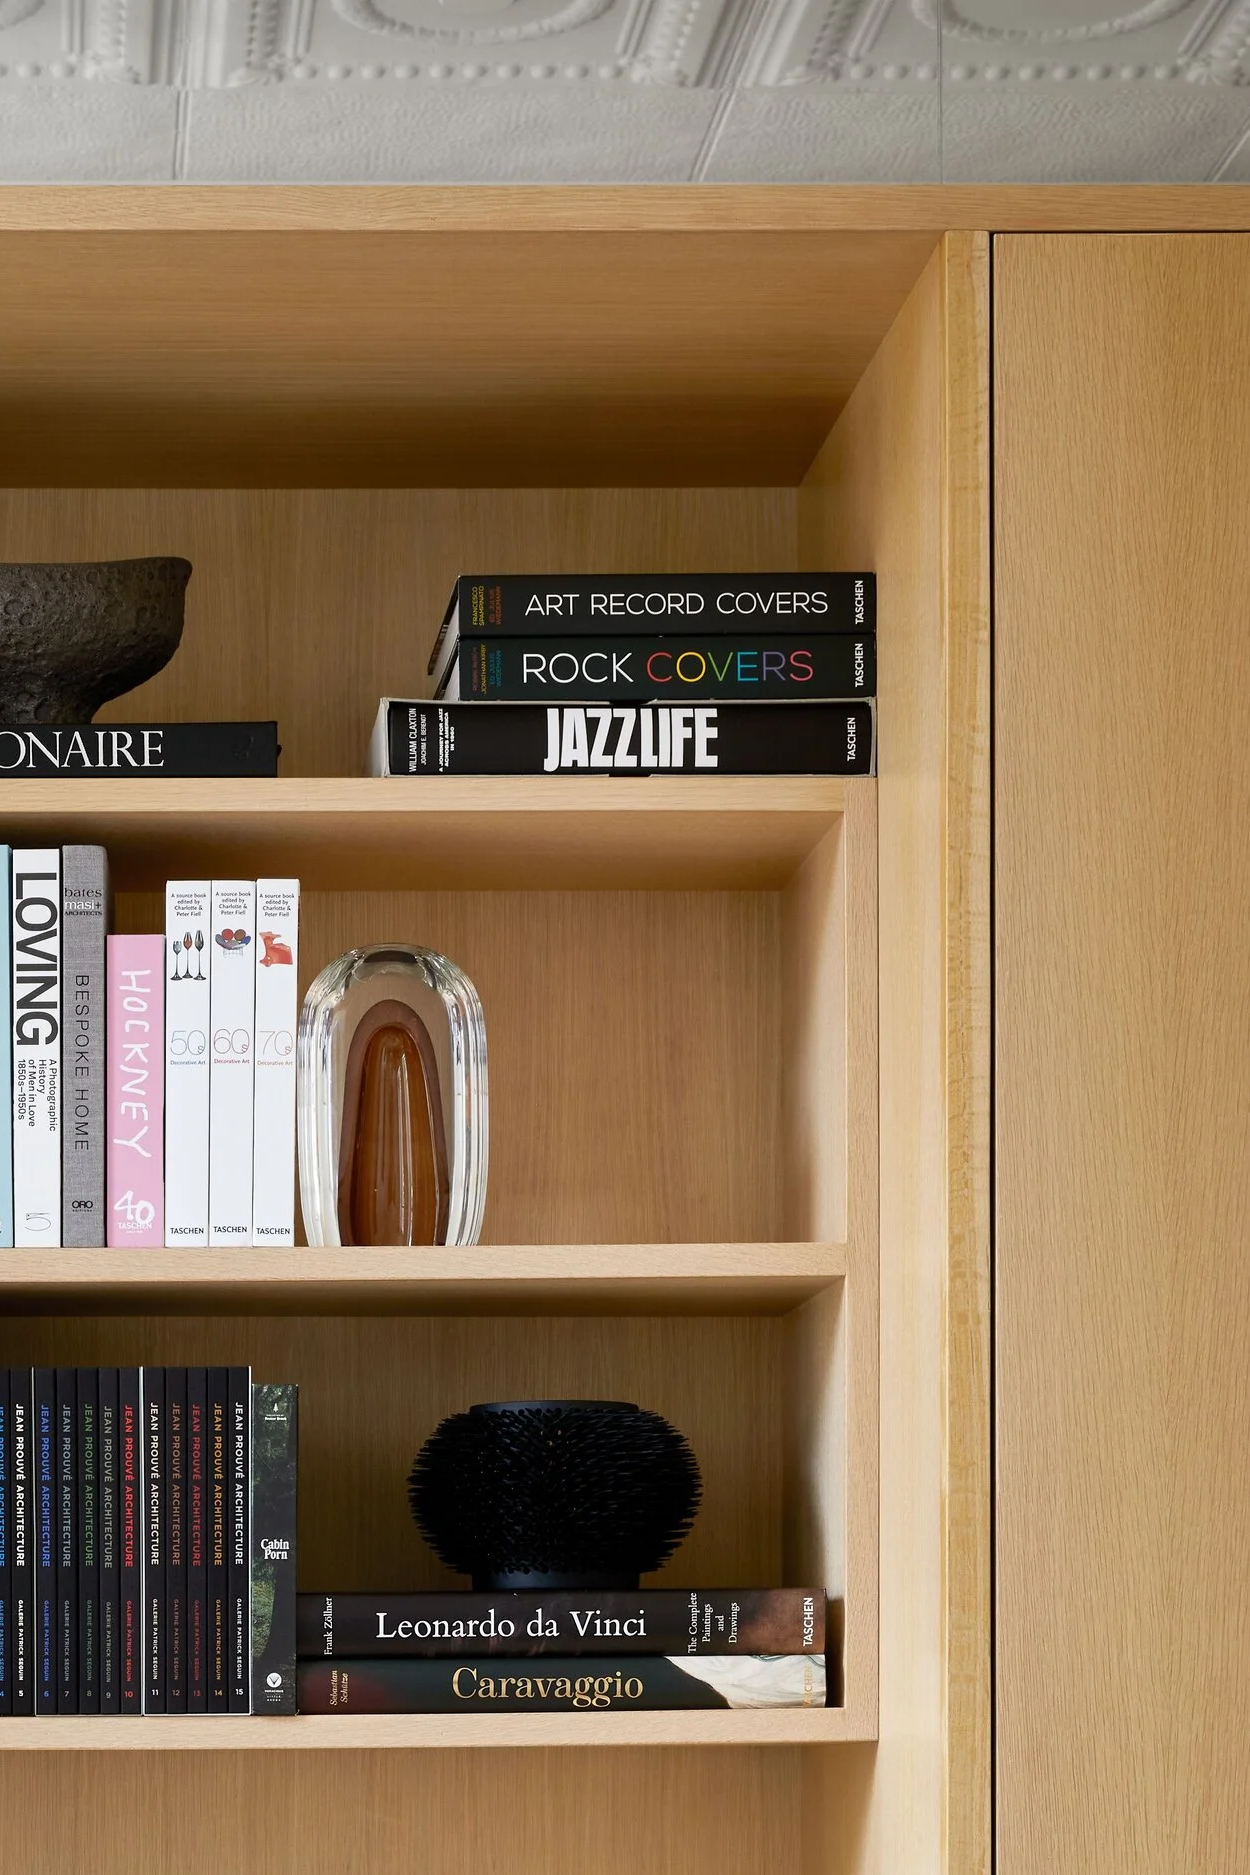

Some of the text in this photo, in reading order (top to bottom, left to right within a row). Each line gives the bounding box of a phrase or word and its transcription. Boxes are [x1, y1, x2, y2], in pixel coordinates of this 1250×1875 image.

[525, 592, 828, 615] ART RECORD COVERS
[854, 580, 864, 625] TASCHEN
[523, 651, 813, 683] ROCK COVERS
[854, 643, 864, 688] TASCHEN
[408, 708, 418, 773] WILLIAM CLAXTON
[544, 708, 718, 771] JAZZLIFE
[846, 717, 857, 762] TASCHEN
[64, 887, 103, 898] bates
[15, 872, 58, 1046] LOVING
[36, 1059, 47, 1094] History
[74, 975, 90, 1151] BESPOKE HOME
[113, 968, 153, 1158] HOCKNEY
[28, 1059, 37, 1127] of Men in Love
[47, 1058, 58, 1132] A Photographic
[71, 1199, 94, 1208] ORO
[114, 1190, 155, 1223] 40
[169, 1227, 205, 1235] TASCHEN
[213, 1225, 248, 1233] TASCHEN
[256, 1227, 291, 1235] TASCHEN
[15, 1403, 27, 1567] JEAN PROUVÉ ARCHITECTURE
[124, 1404, 135, 1568] JEAN PROUVÉ ARCHITECTURE
[150, 1402, 161, 1565] JEAN PROUVÉ ARCHITECTURE
[235, 1401, 245, 1565] JEAN PROUVÉ ARCHITECTURE
[260, 1538, 289, 1560] Cabin Porn
[322, 1597, 333, 1655] Frank Zöllner
[376, 1608, 646, 1637] Leonardo da Vinci
[687, 1592, 700, 1654] The Complete
[701, 1603, 714, 1642] Paintings
[714, 1615, 725, 1632] and
[728, 1602, 741, 1643] Drawings
[802, 1597, 814, 1647] TASCHEN
[453, 1668, 643, 1707] Caravaggio
